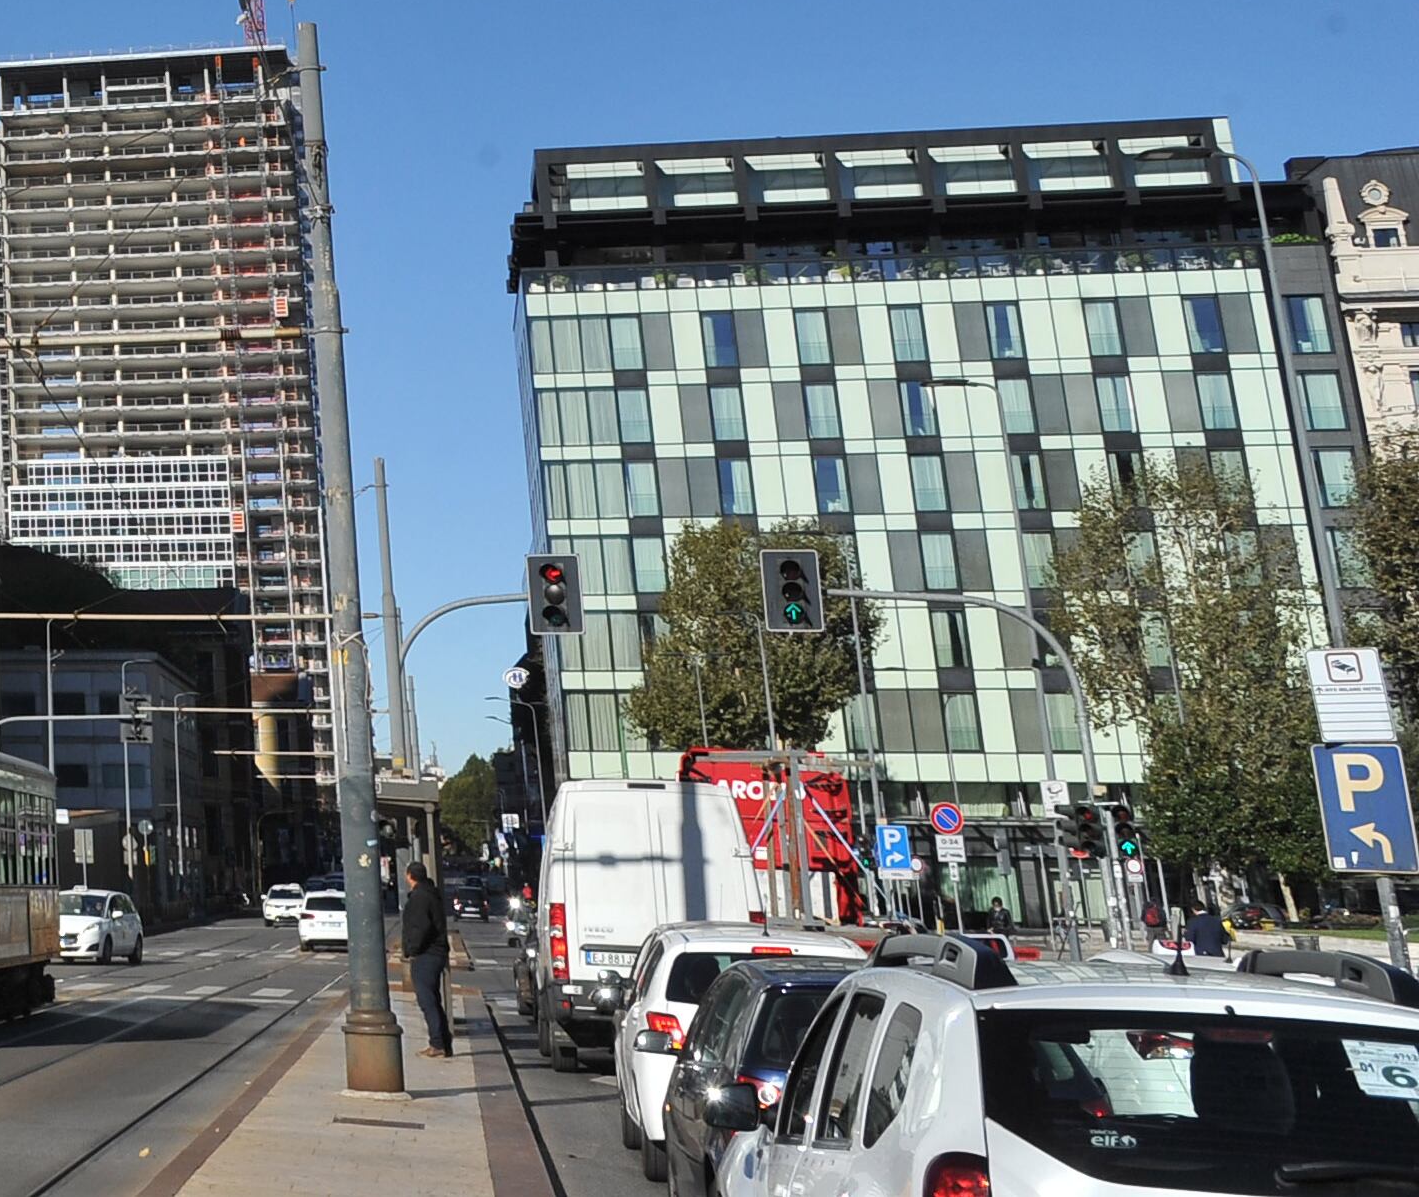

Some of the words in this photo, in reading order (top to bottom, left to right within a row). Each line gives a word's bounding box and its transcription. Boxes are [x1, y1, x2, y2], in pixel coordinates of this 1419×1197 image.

[1331, 753, 1384, 812] P
[883, 828, 901, 850] P
[1381, 1066, 1418, 1089] 6
